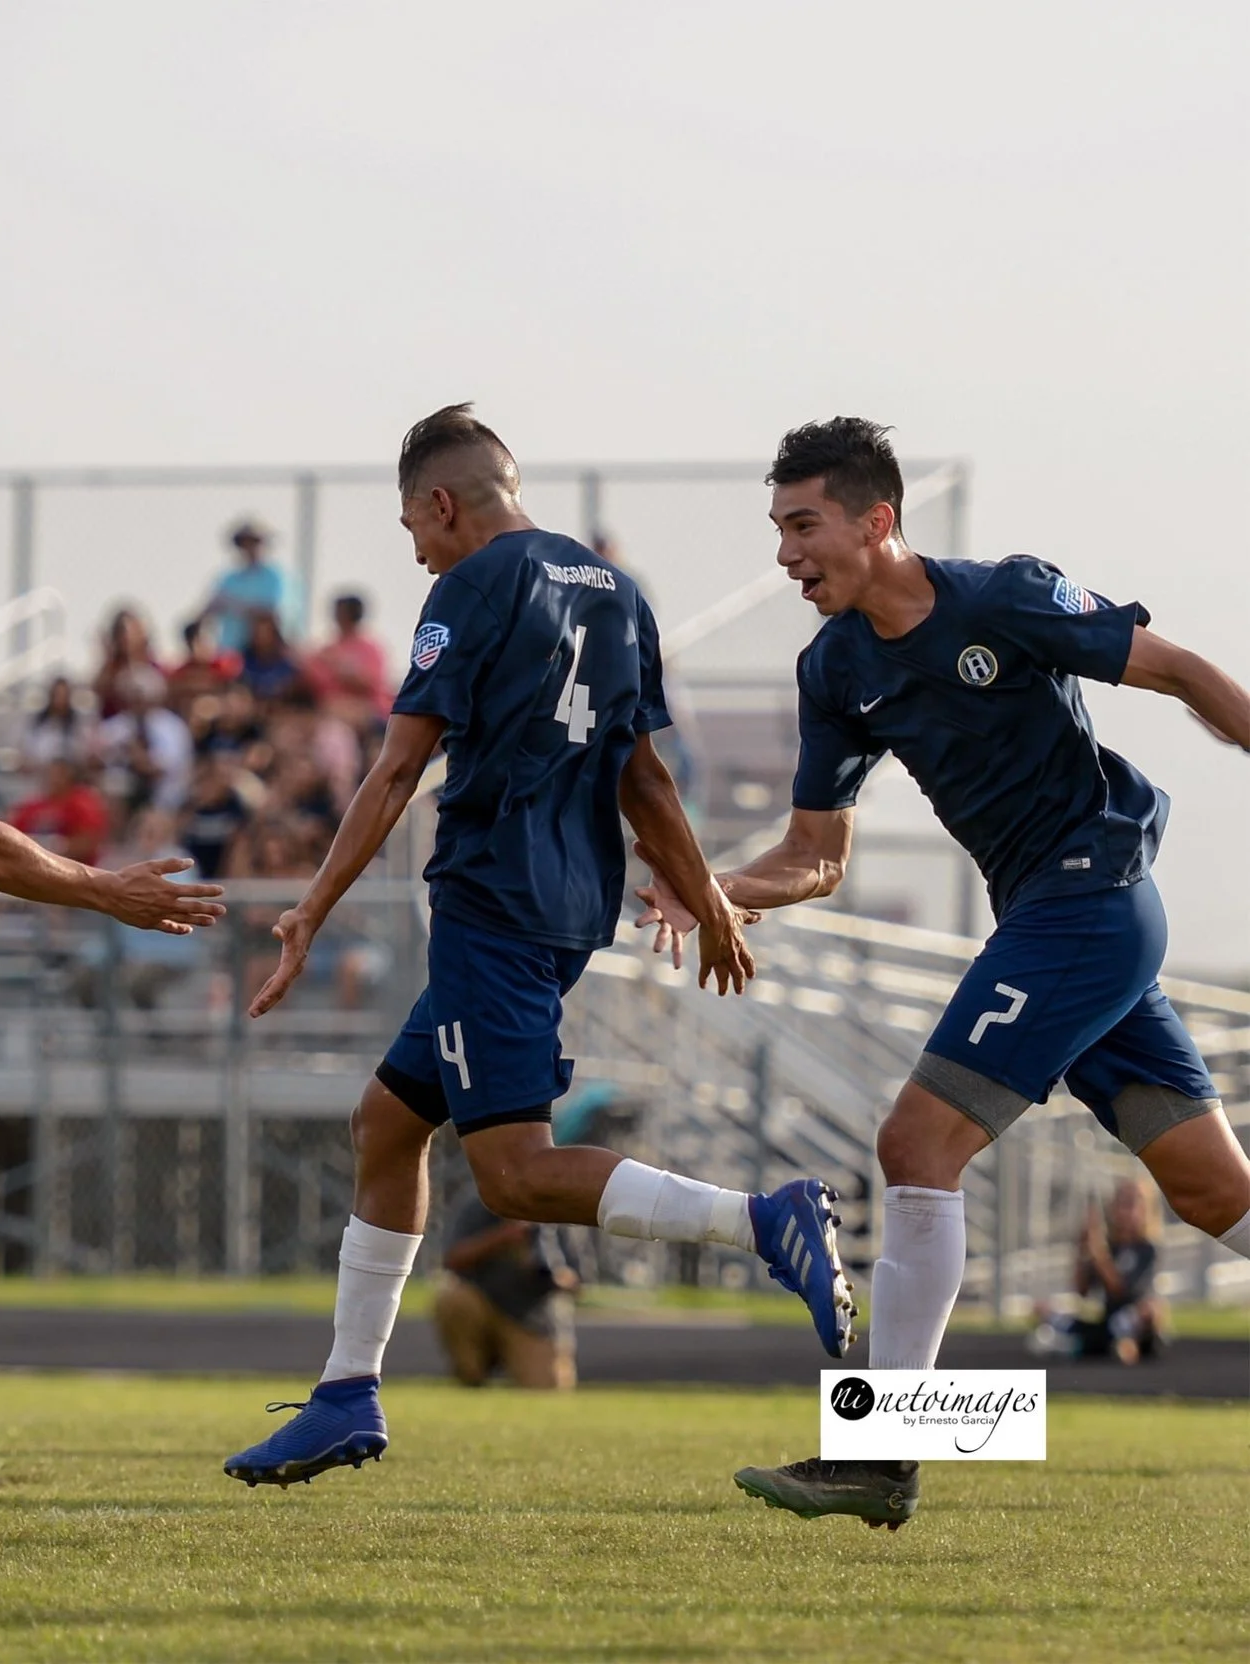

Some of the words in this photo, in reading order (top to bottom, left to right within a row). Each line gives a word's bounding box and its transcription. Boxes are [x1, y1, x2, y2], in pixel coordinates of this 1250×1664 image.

[554, 625, 596, 744] 4
[968, 982, 1028, 1045] 7
[438, 1021, 471, 1090] 4
